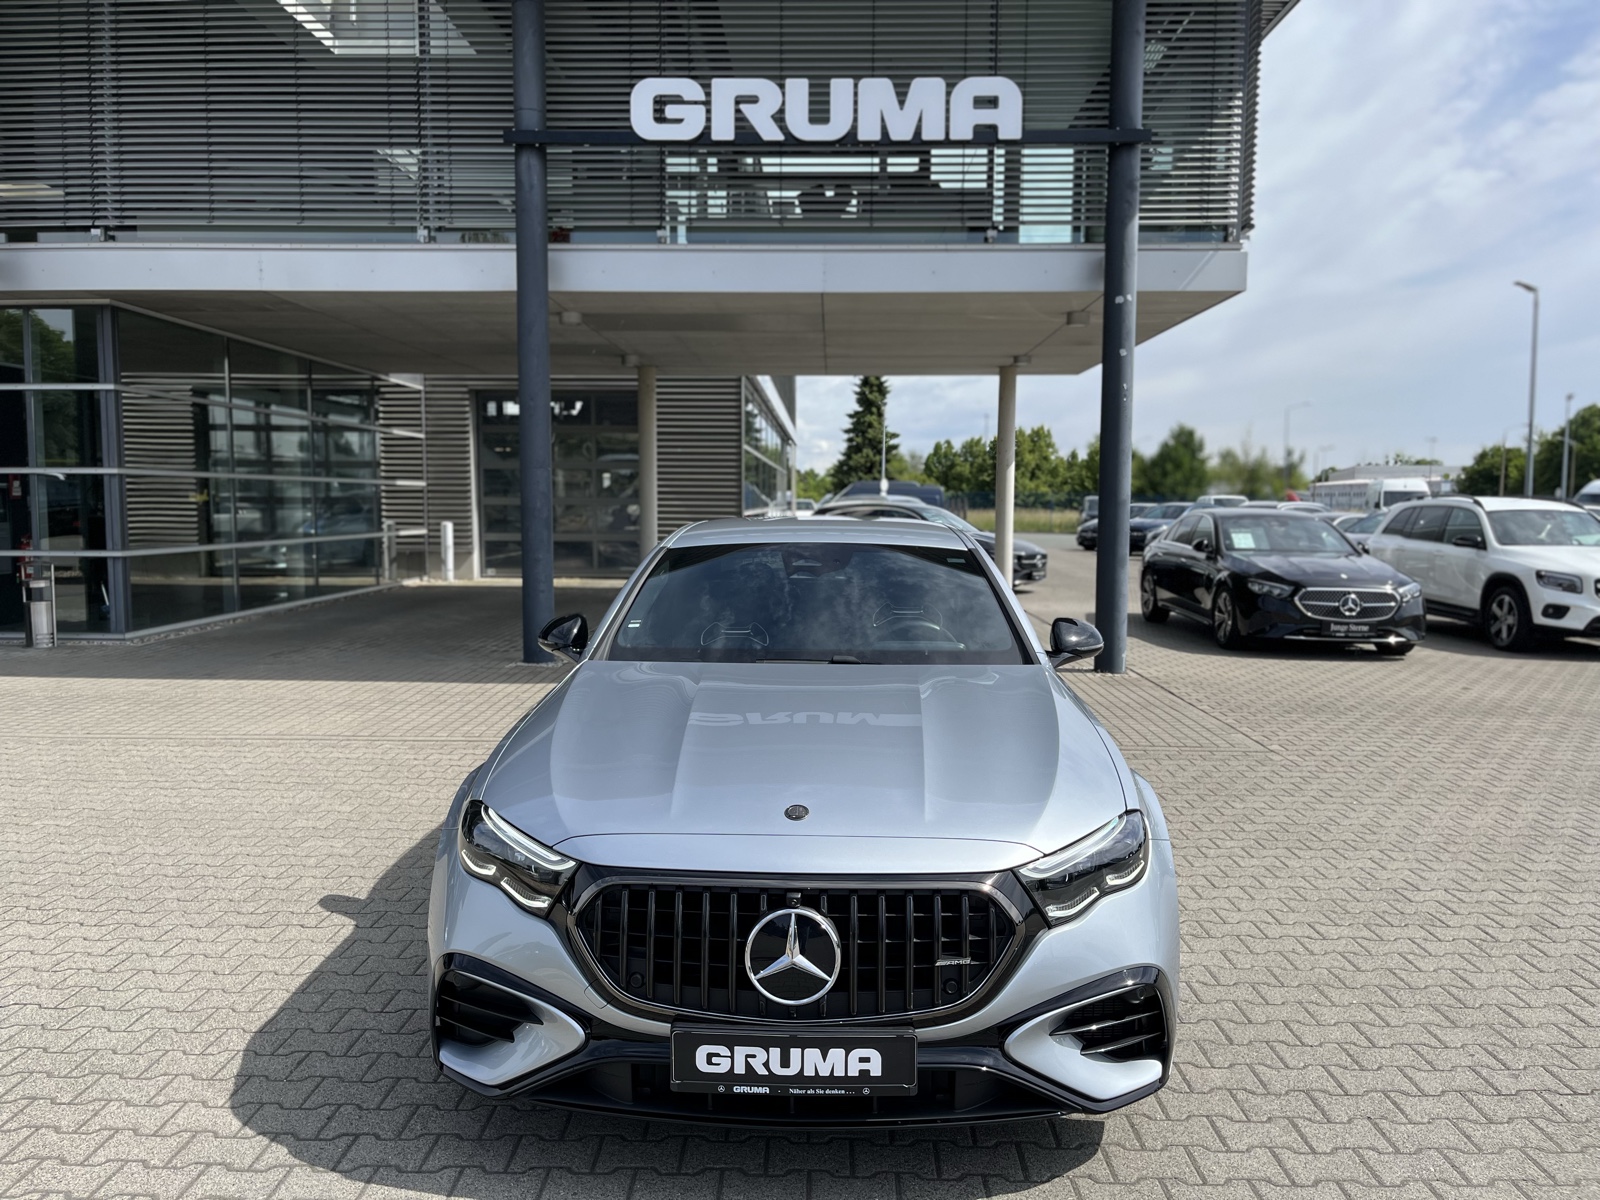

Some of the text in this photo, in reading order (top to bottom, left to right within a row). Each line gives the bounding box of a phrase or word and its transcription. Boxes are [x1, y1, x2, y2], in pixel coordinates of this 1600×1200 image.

[629, 76, 1023, 142] GRUMA
[695, 1044, 882, 1077] GRUMA
[733, 1085, 770, 1094] GRUMA
